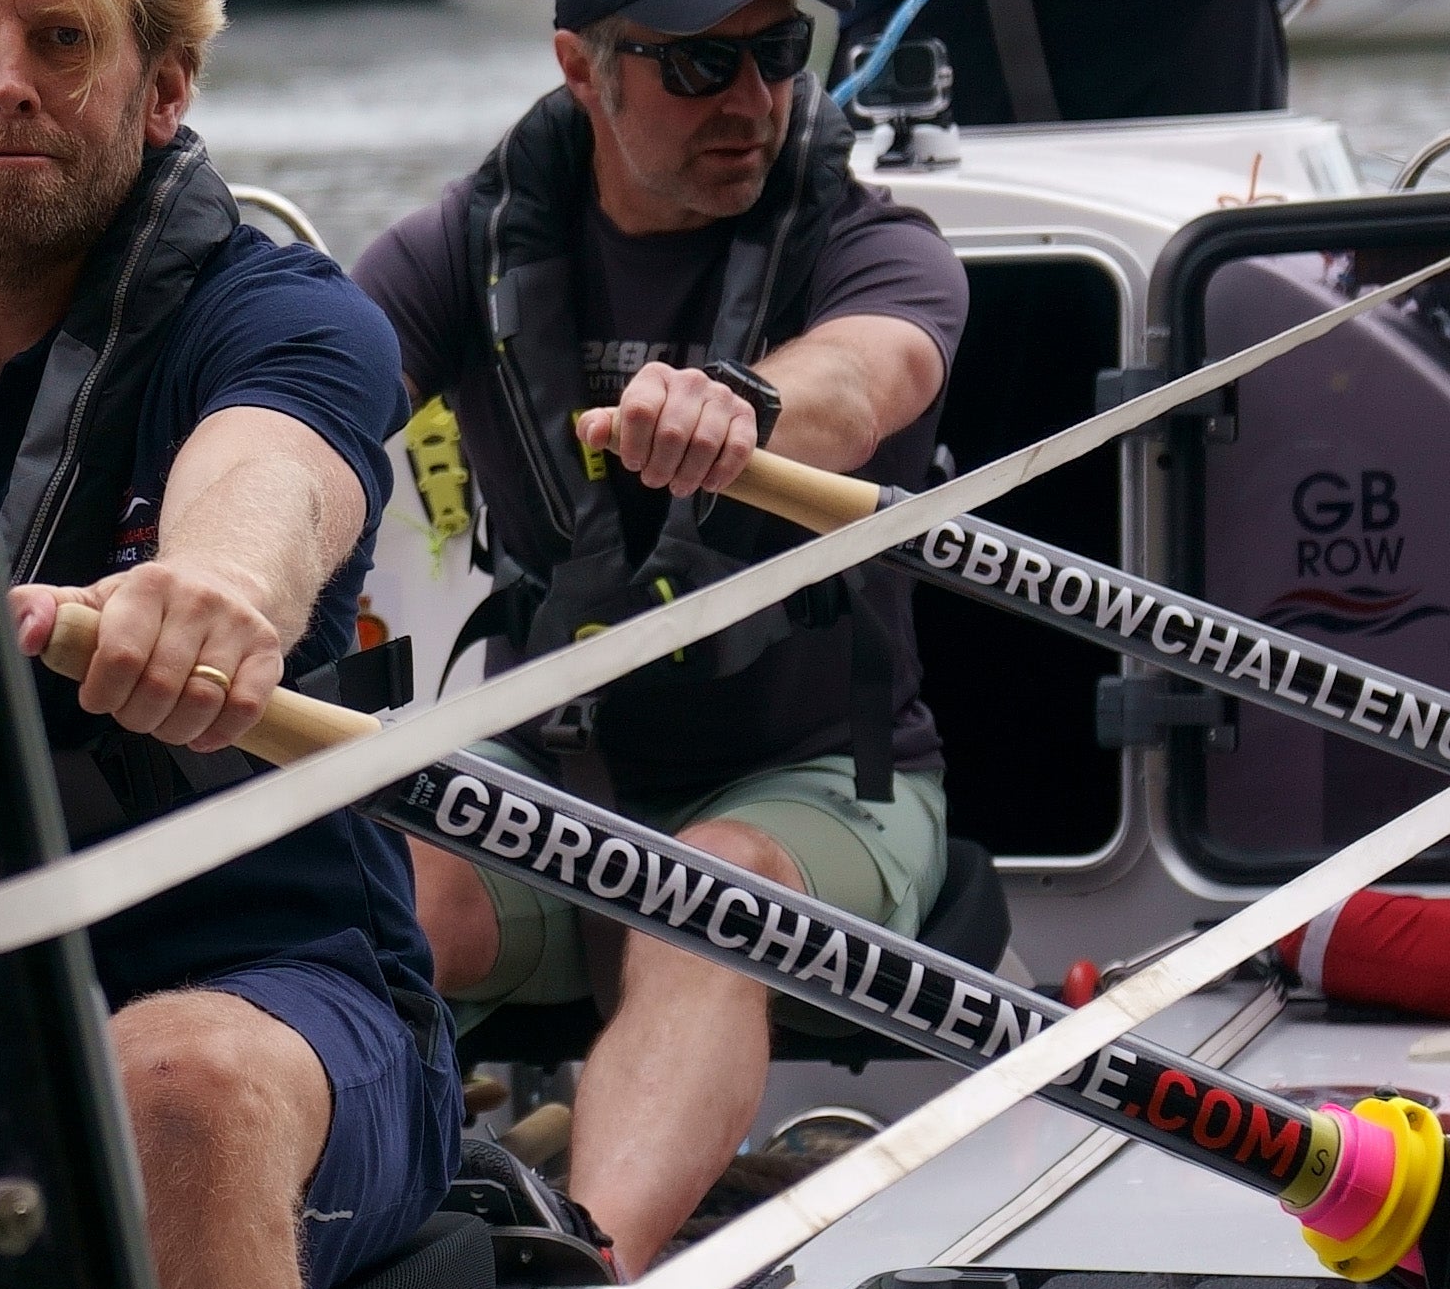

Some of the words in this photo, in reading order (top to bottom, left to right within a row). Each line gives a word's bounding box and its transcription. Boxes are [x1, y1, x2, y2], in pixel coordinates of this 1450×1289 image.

[1292, 470, 1400, 535] GB
[1298, 536, 1405, 578] ROW
[406, 772, 430, 806] Ocean
[435, 774, 1302, 1177] GBROWCHALLENE.COM
